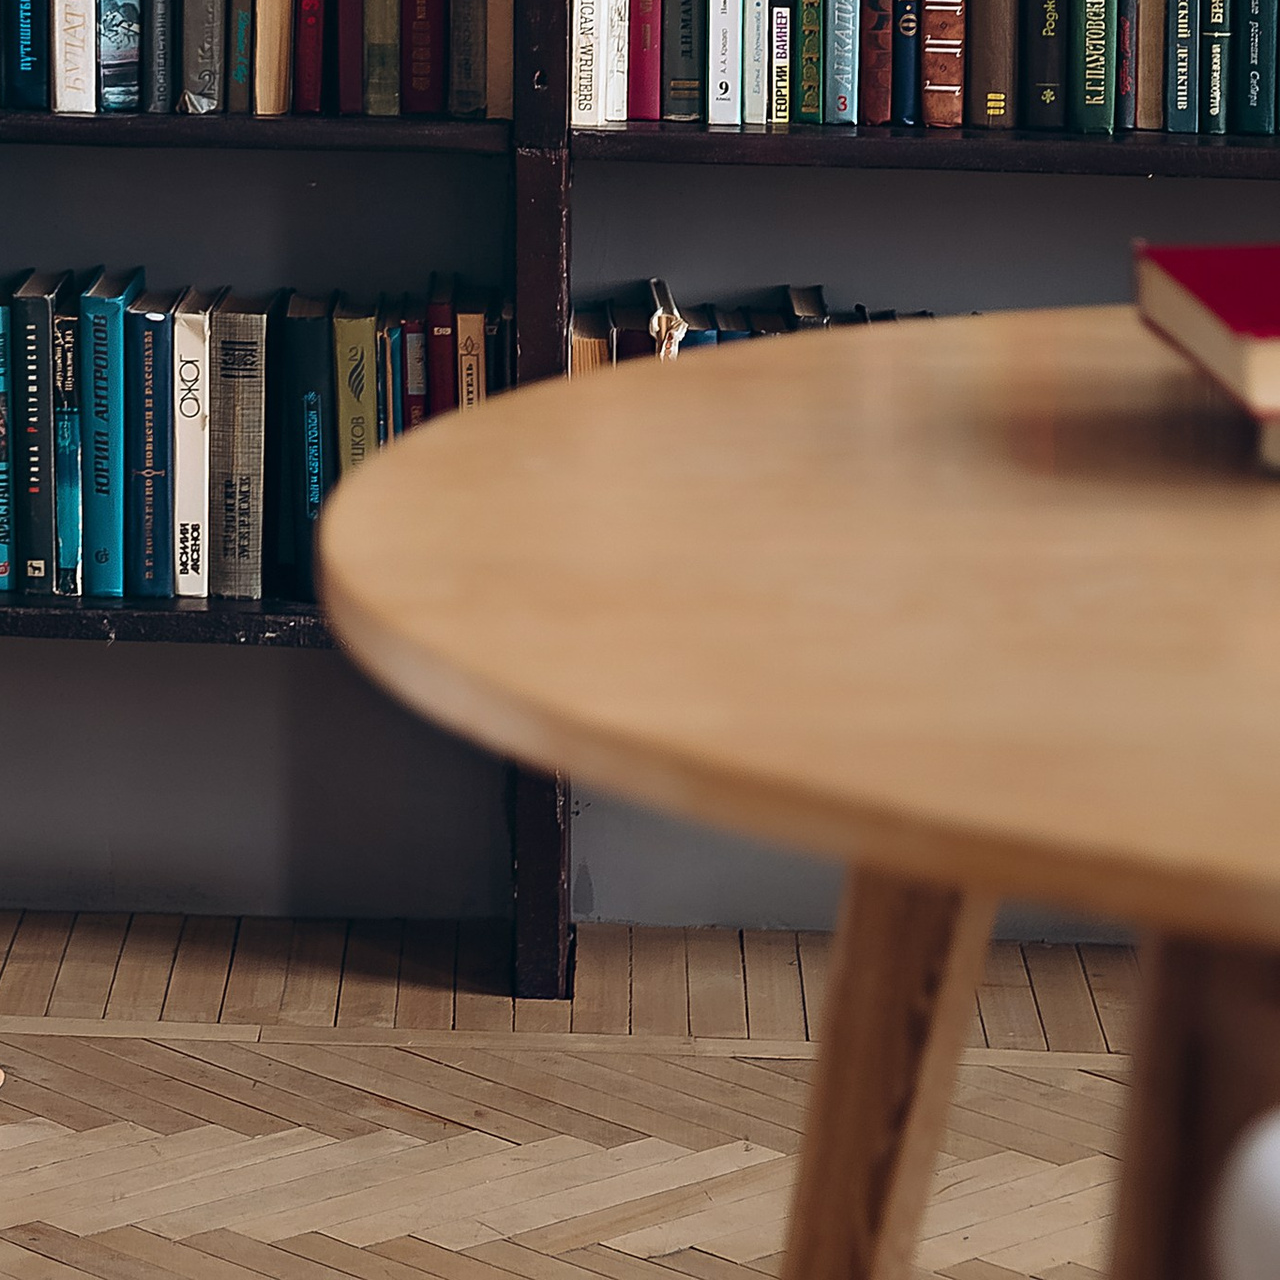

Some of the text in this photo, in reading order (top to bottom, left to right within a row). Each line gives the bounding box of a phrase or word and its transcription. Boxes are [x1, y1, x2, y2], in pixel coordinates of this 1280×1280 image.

[62, 3, 86, 94] БУЛАТ
[579, 42, 594, 112] WRITERS
[835, 95, 849, 112] 3
[91, 313, 110, 497] ЮРИЙ АНТРОПОВ
[179, 354, 202, 419] ОЖОГ
